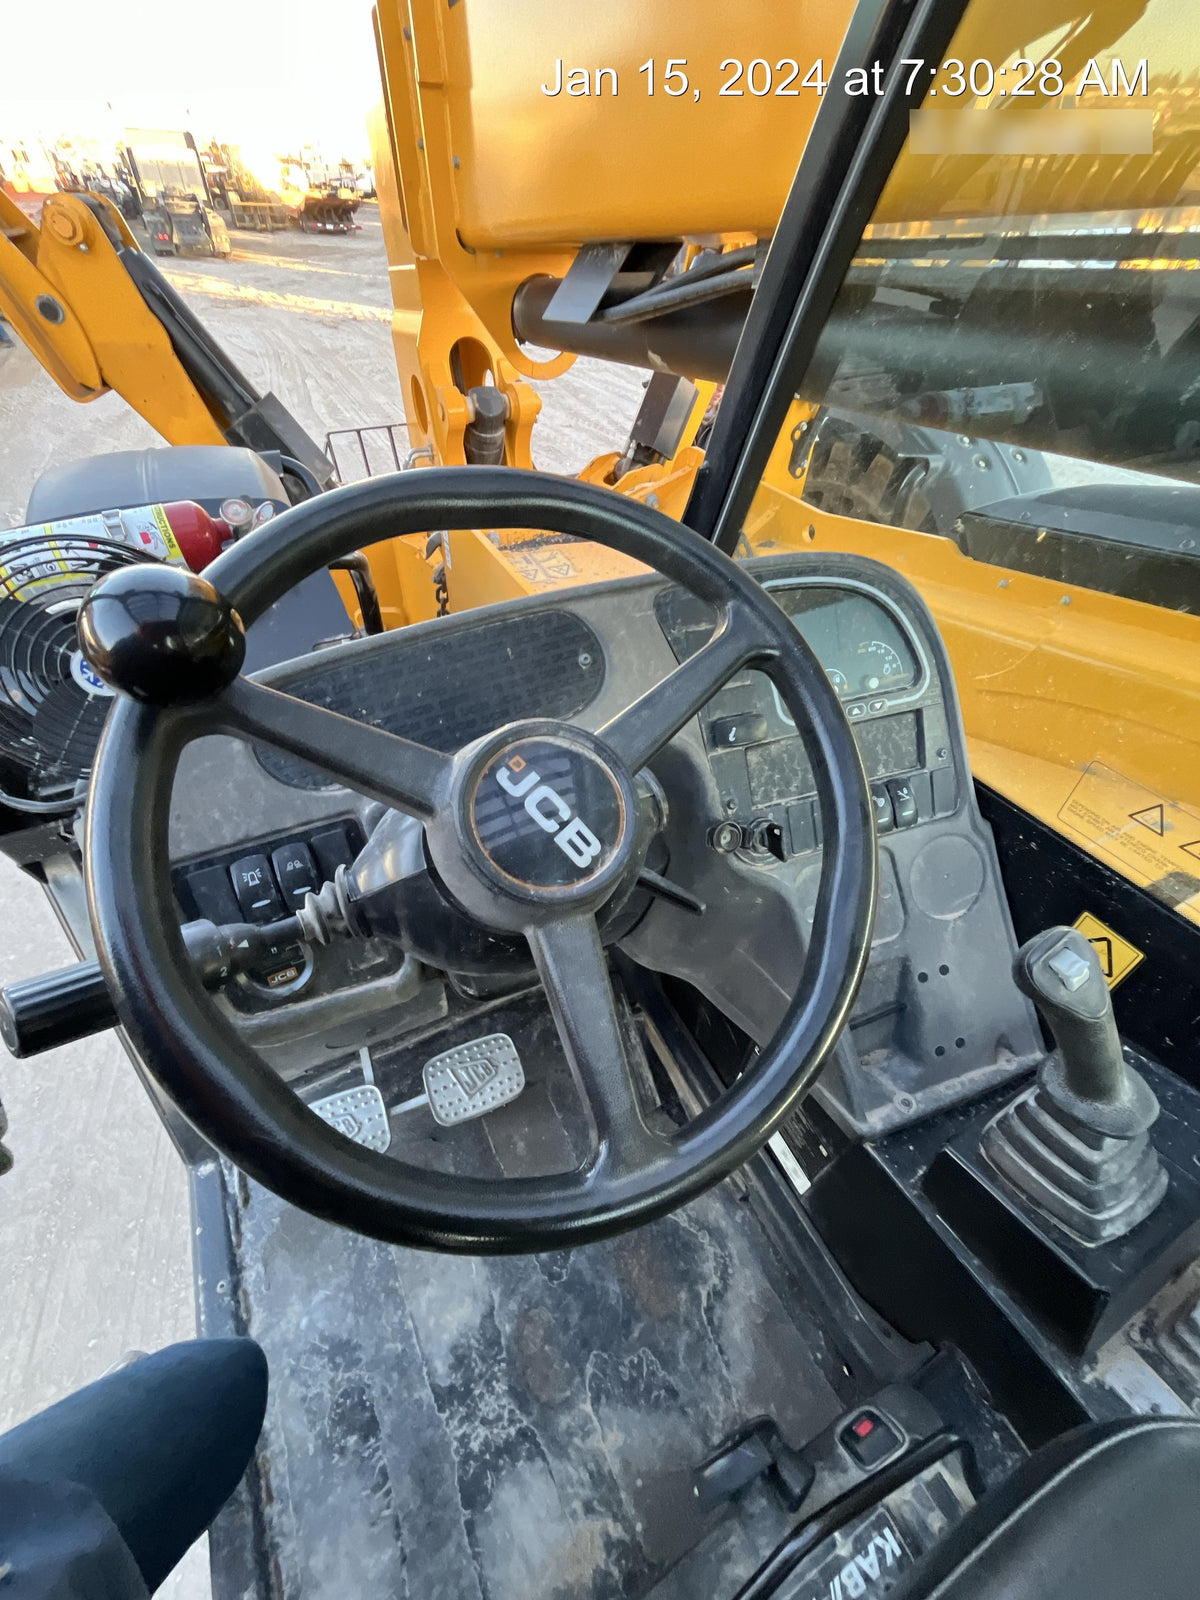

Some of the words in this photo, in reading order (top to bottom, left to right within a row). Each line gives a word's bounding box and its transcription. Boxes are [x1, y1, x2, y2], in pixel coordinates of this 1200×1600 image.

[496, 766, 602, 868] JCB
[220, 966, 228, 978] 2
[271, 970, 296, 984] JCB
[457, 1060, 493, 1092] JCB
